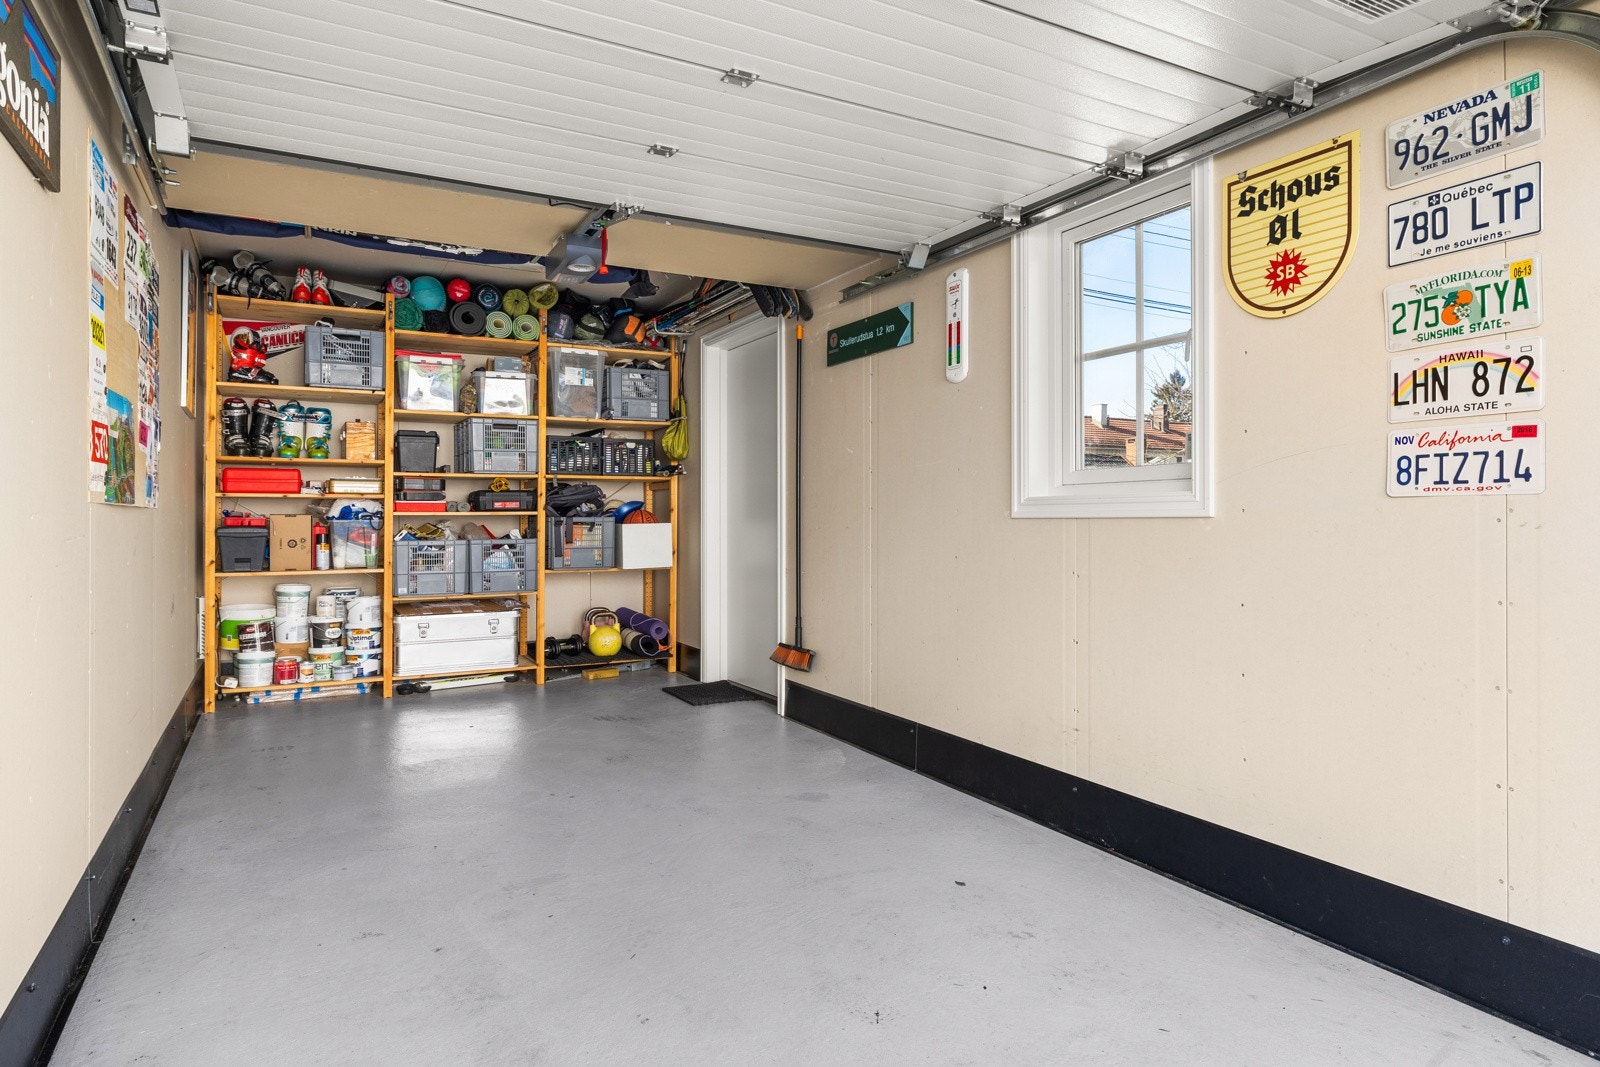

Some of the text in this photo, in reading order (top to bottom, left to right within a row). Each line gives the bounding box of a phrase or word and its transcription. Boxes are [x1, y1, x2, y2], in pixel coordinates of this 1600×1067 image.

[1423, 89, 1498, 125] NEVADA
[1421, 141, 1502, 172] THE SILVER STATE
[1237, 166, 1341, 217] Schous
[1442, 182, 1494, 203] Québec
[1266, 209, 1302, 246] Øl
[1393, 182, 1534, 251] 780 LTP
[1420, 231, 1503, 257] Je me souviens
[1276, 264, 1295, 281] SB
[1513, 264, 1532, 278] 06-13
[1391, 277, 1530, 335] 275 TYA
[261, 324, 291, 332] VANCOUVER
[886, 324, 895, 334] km
[1417, 319, 1502, 342] SUNSHINE STATE
[1439, 350, 1484, 364] HAWAII
[1394, 355, 1535, 406] LHN 872
[1425, 401, 1499, 416] ALOHA STATE
[1394, 430, 1513, 451] NOV California
[1396, 449, 1532, 486] 8FIZ714
[1423, 485, 1502, 493] dmv.ca.gov
